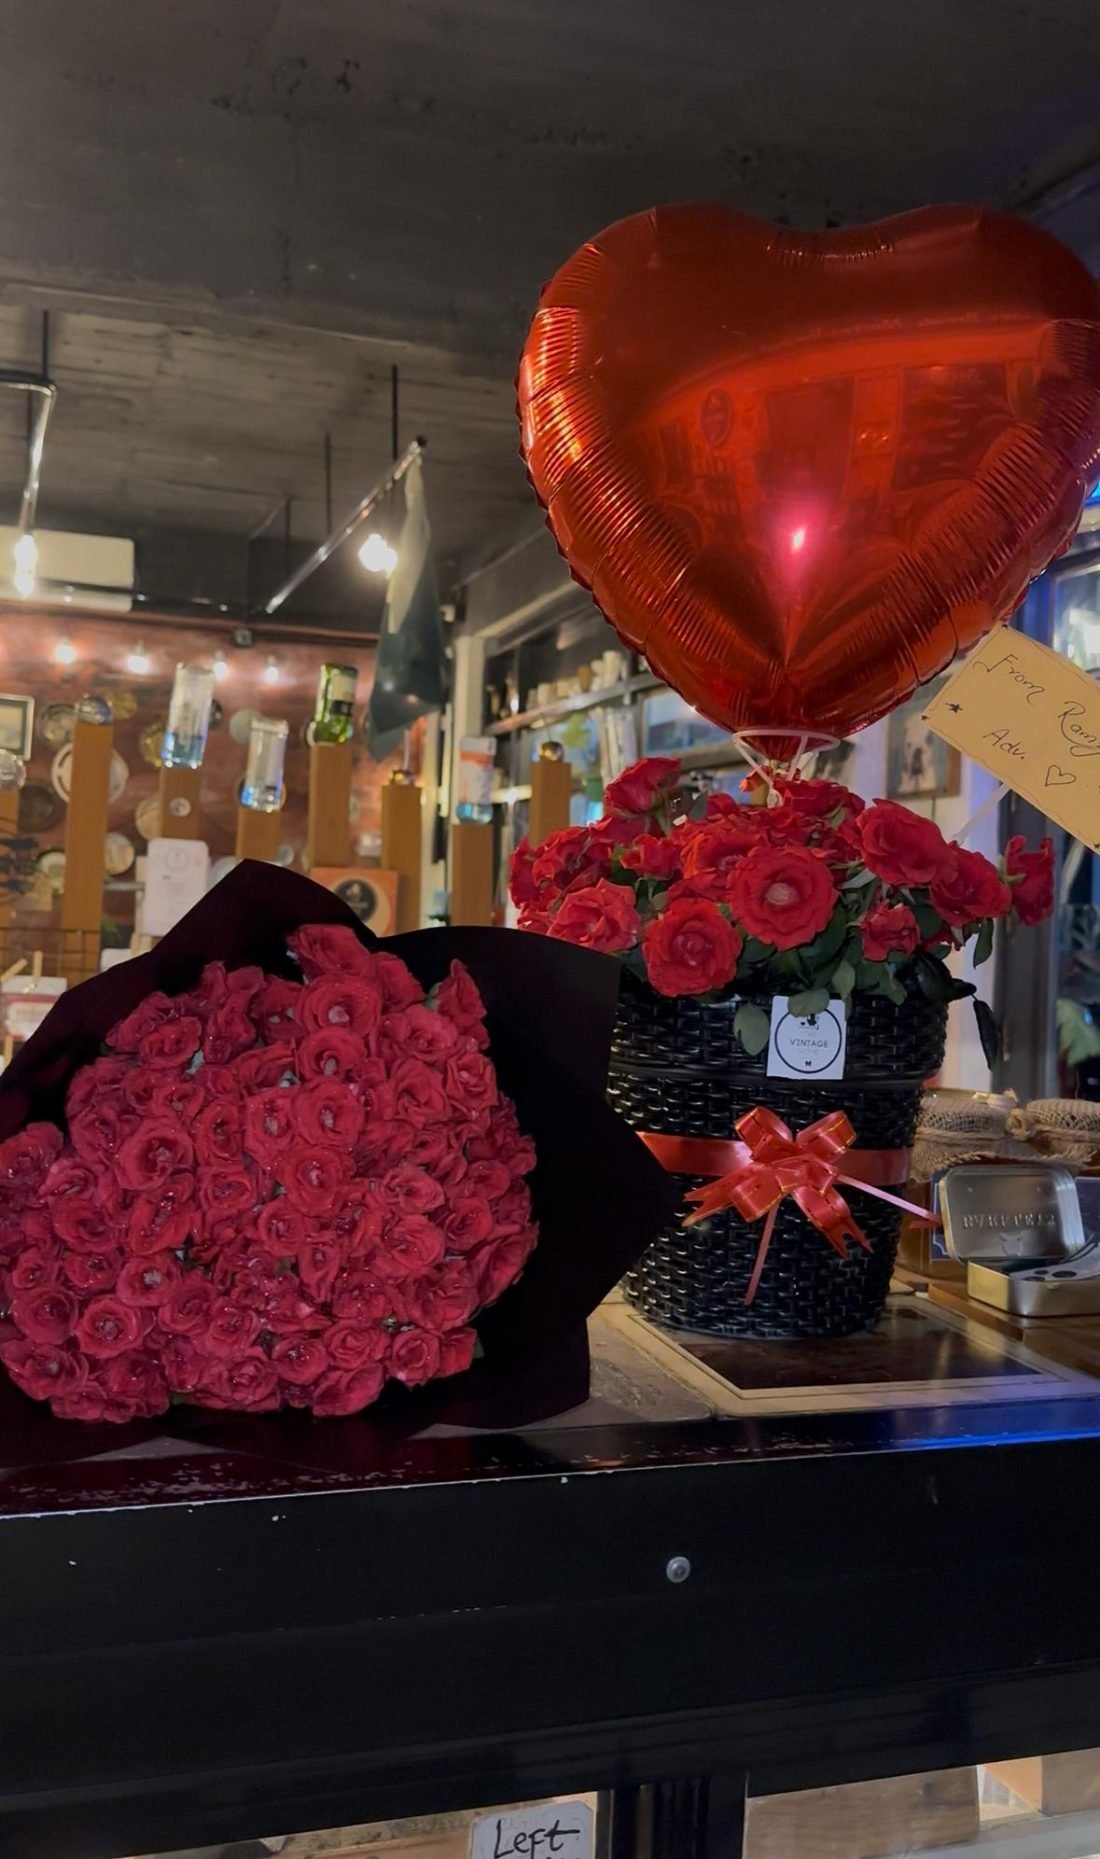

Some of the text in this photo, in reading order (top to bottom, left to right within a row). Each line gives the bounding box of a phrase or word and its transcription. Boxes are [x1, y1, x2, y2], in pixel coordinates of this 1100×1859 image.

[972, 653, 1046, 706] From
[790, 1038, 829, 1049] VINTAGE
[493, 1818, 580, 1859] Left
